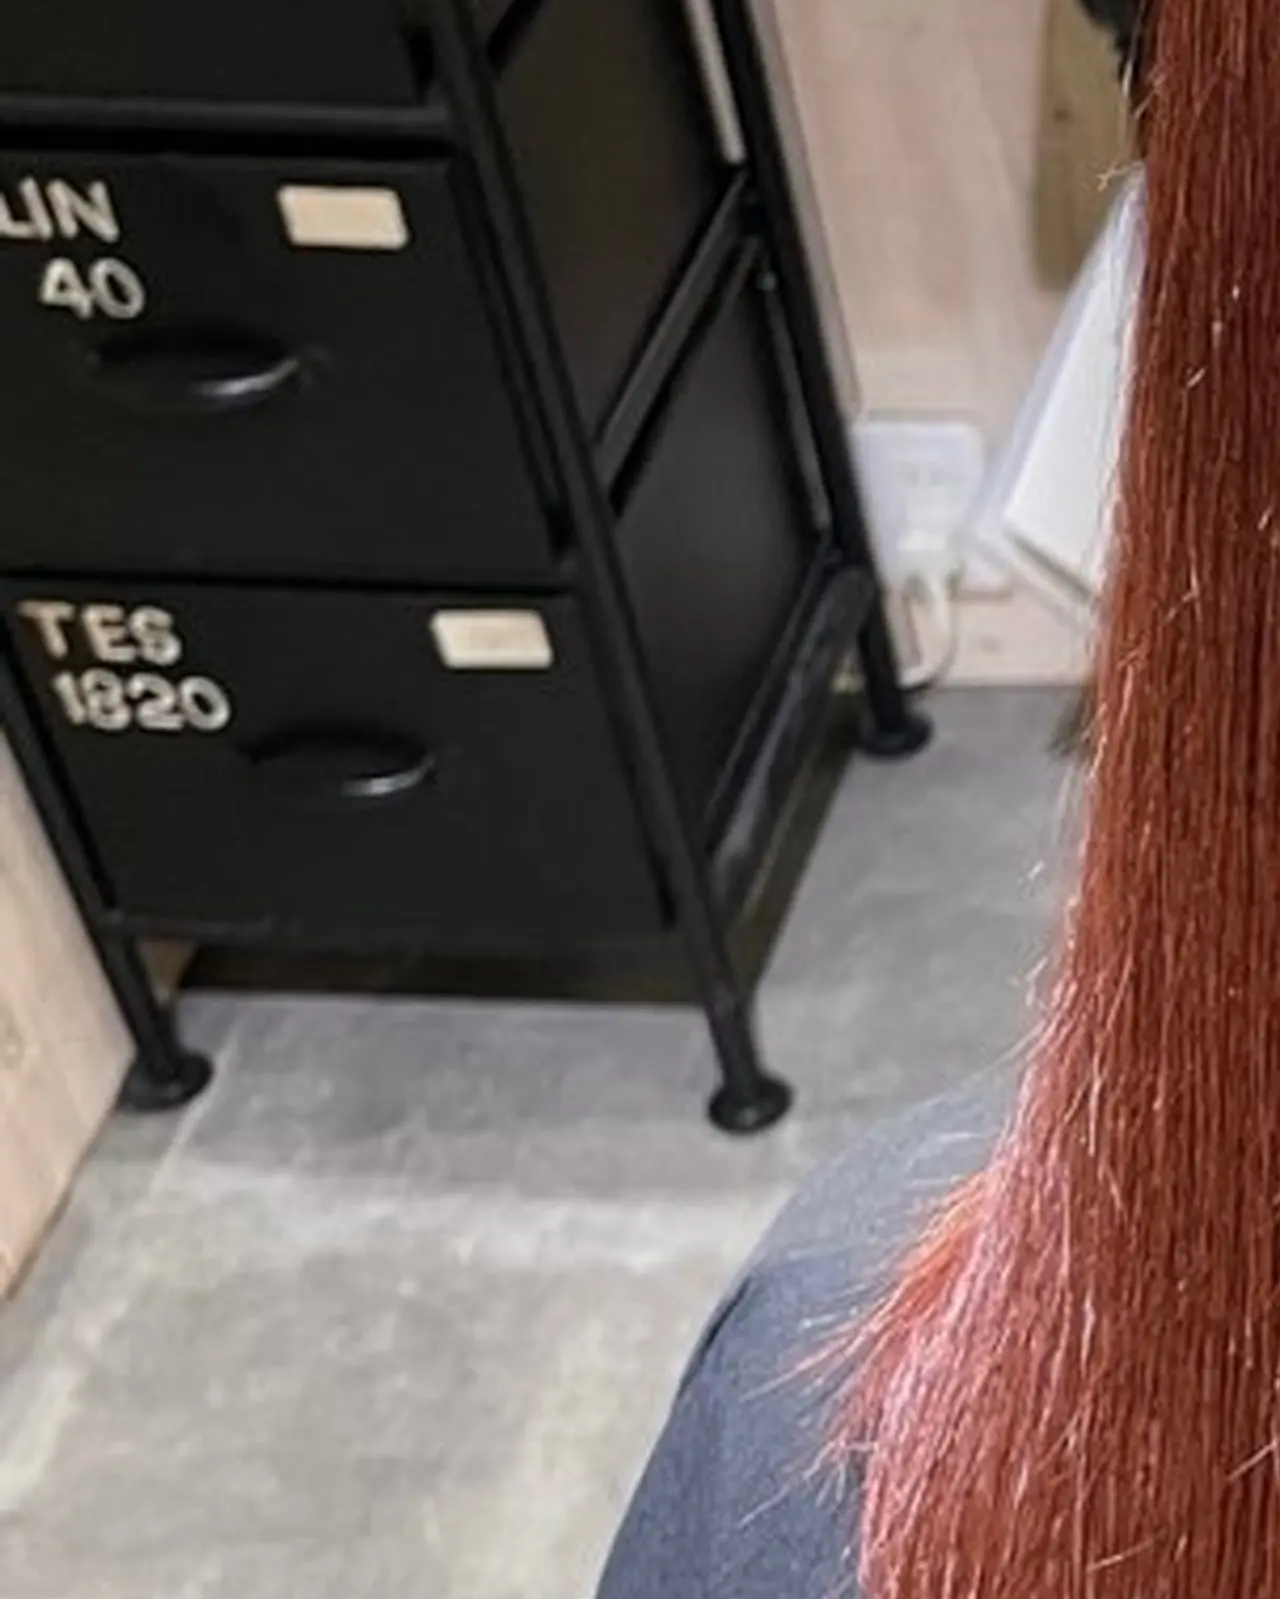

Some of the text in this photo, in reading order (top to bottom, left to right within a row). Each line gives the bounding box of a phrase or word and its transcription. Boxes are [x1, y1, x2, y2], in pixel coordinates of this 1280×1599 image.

[41, 257, 145, 318] 40
[18, 601, 182, 666] TES
[54, 668, 231, 731] 1820
